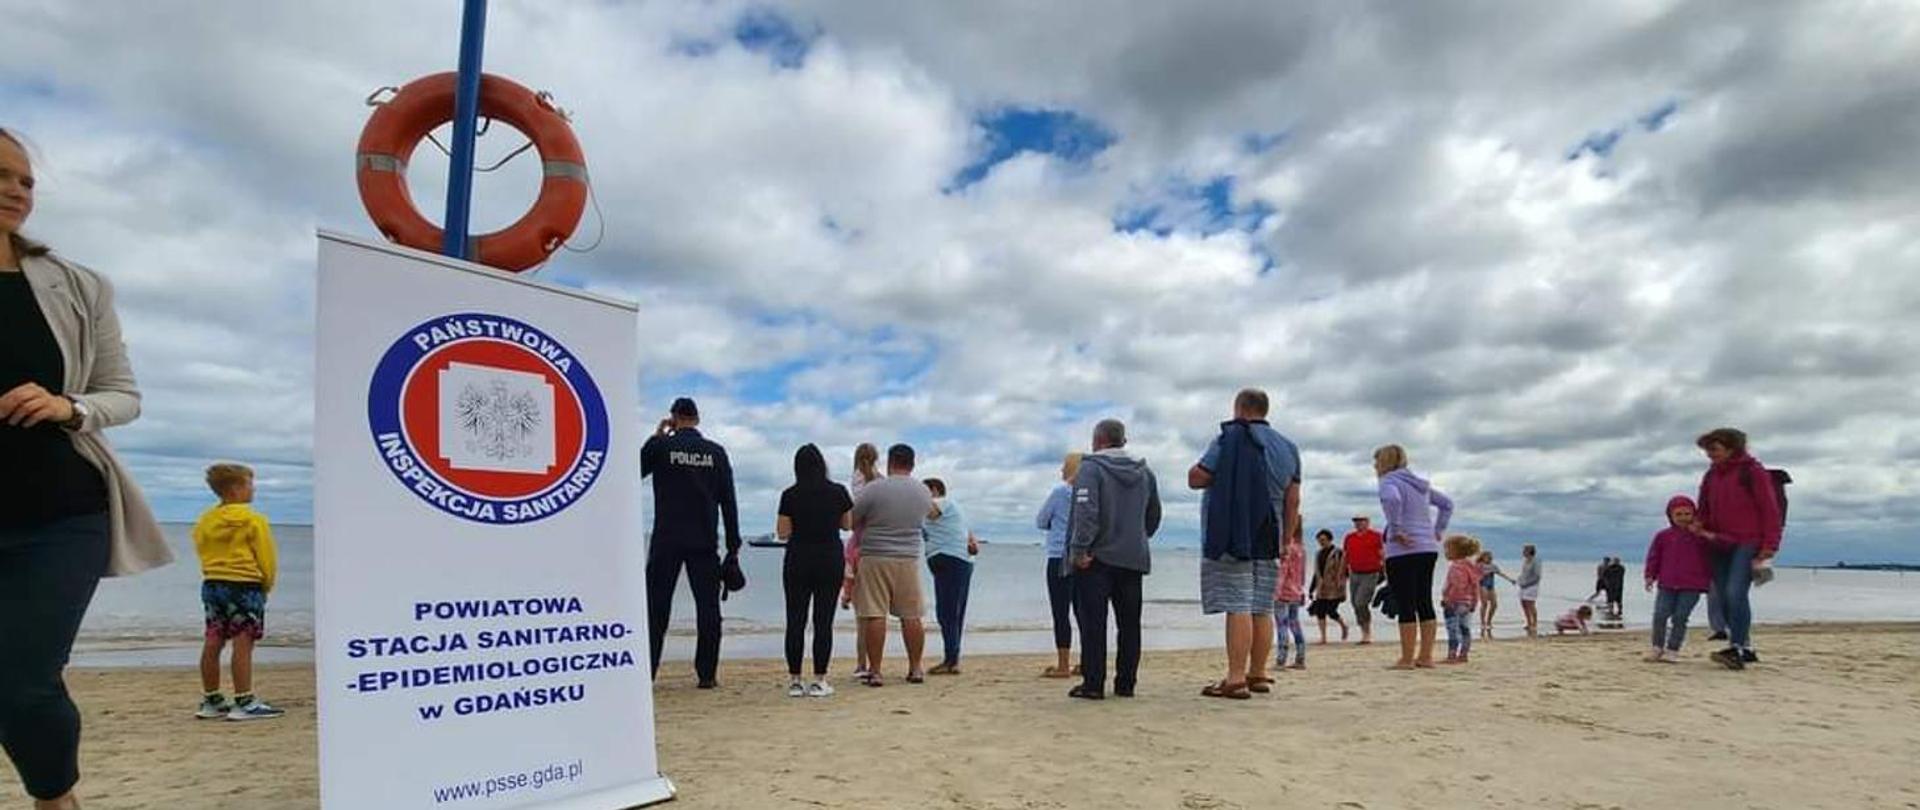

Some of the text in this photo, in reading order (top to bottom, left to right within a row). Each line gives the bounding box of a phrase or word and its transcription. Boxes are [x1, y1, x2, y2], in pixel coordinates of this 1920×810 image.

[413, 317, 572, 373] PAŃSTWOWA
[378, 432, 603, 521] INSPEKCJA SANITARNA
[670, 451, 714, 467] POLICJA
[414, 596, 583, 621] POWIATOWA
[347, 622, 633, 658] STACJA SANITARNO-
[346, 650, 634, 692] -EPIDEMIOLOGICZNA
[418, 684, 585, 720] w GDAŃSKU
[433, 758, 583, 803] www.psse.gda.pl
